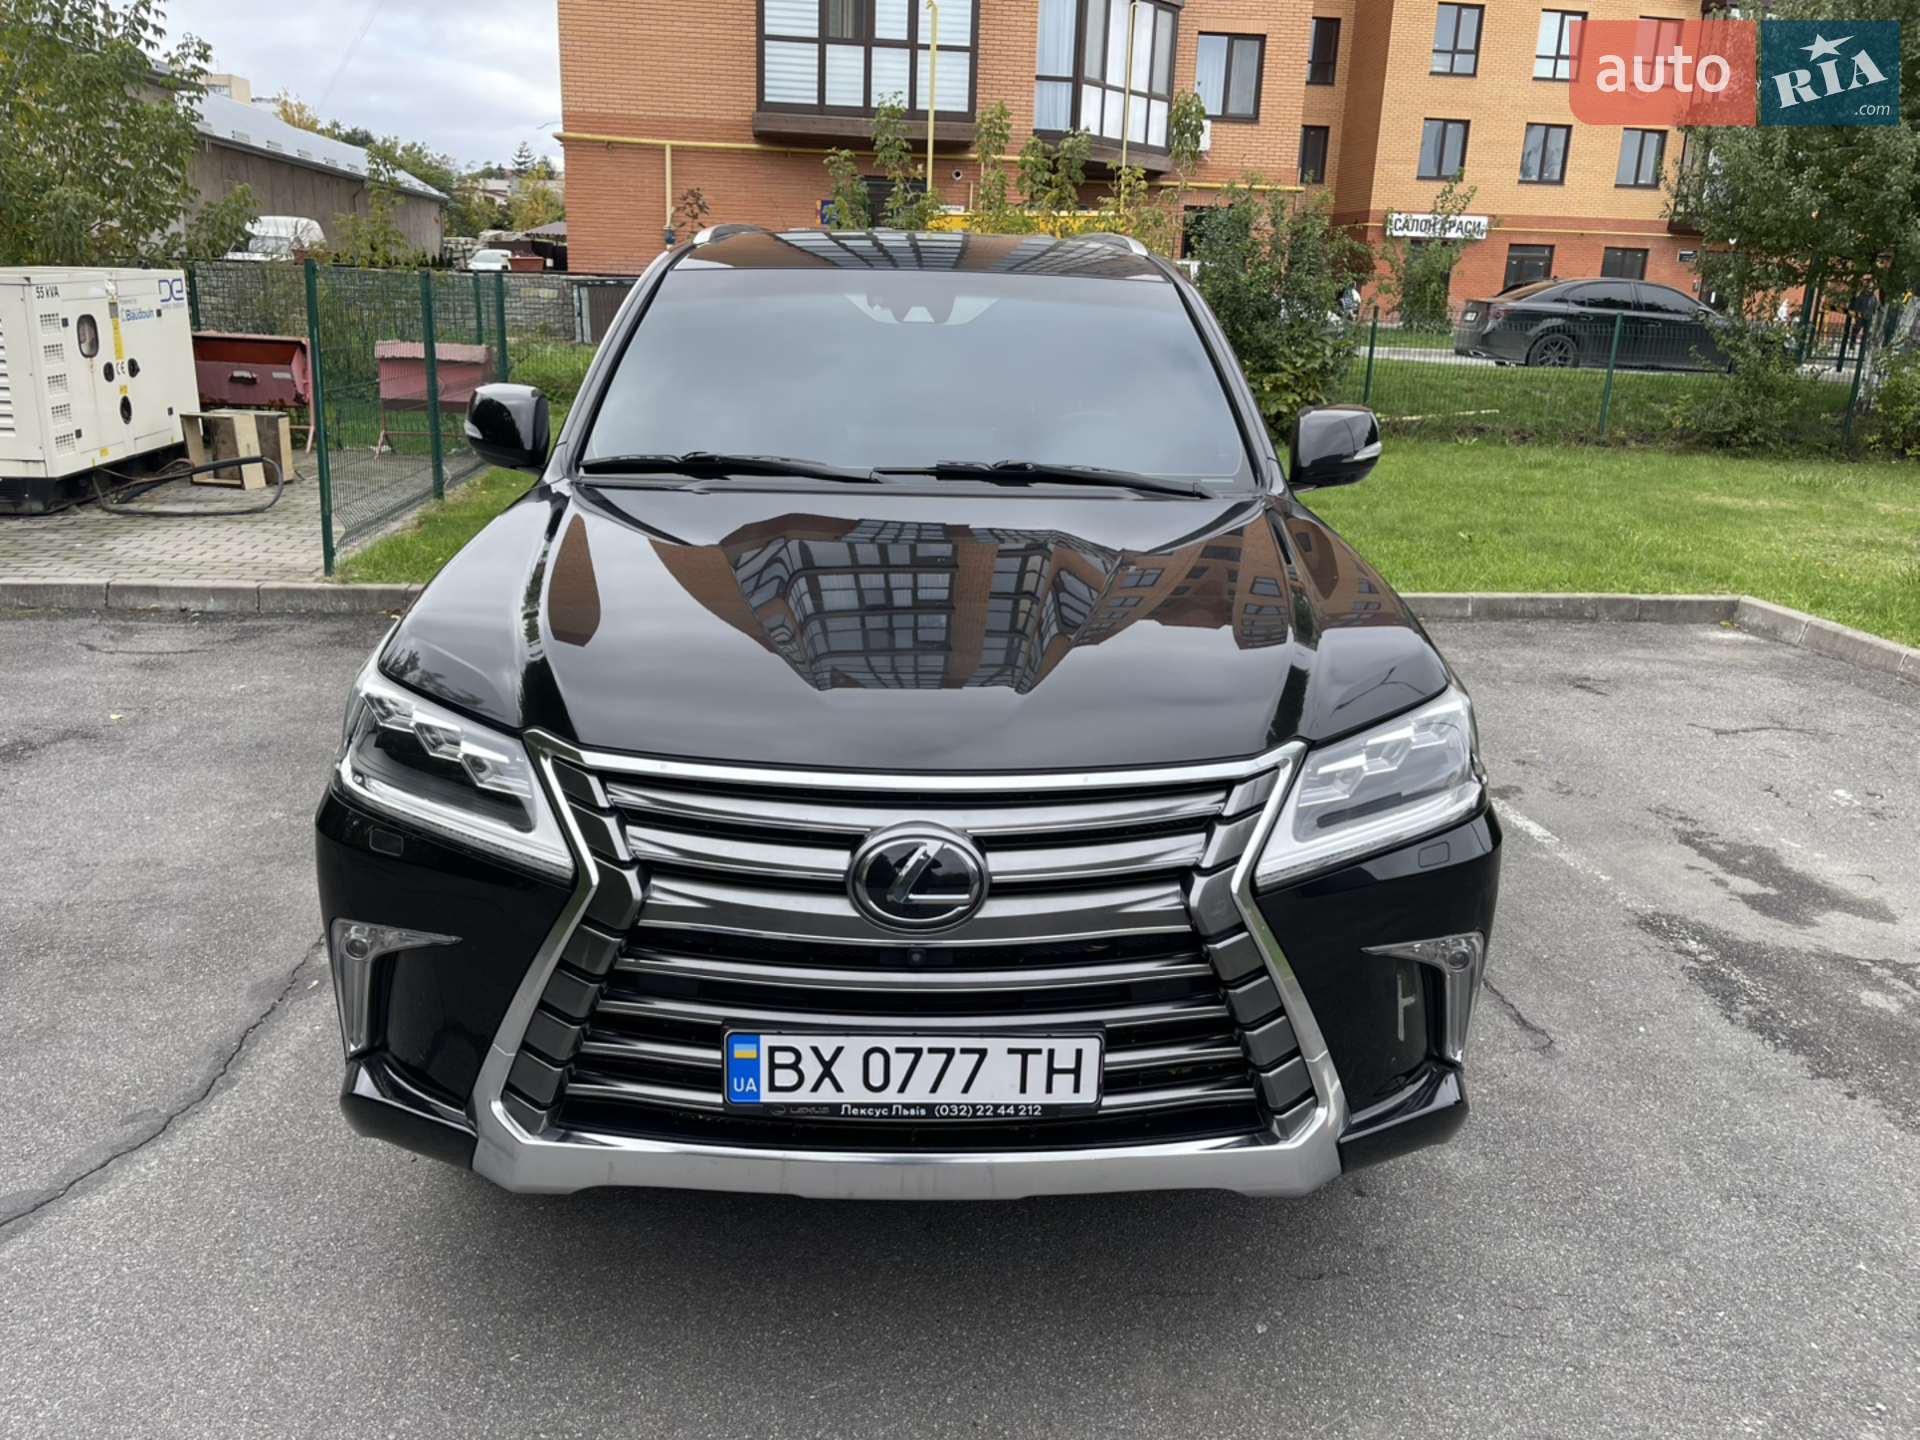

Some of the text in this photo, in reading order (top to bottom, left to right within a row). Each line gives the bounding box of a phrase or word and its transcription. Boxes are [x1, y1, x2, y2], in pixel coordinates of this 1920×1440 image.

[1394, 217, 1438, 233] САЛОН
[767, 1045, 1084, 1094] BX 0777 TH
[733, 1077, 757, 1093] UA
[840, 1103, 1042, 1118] Лексус Львів (032) 22 44 212
